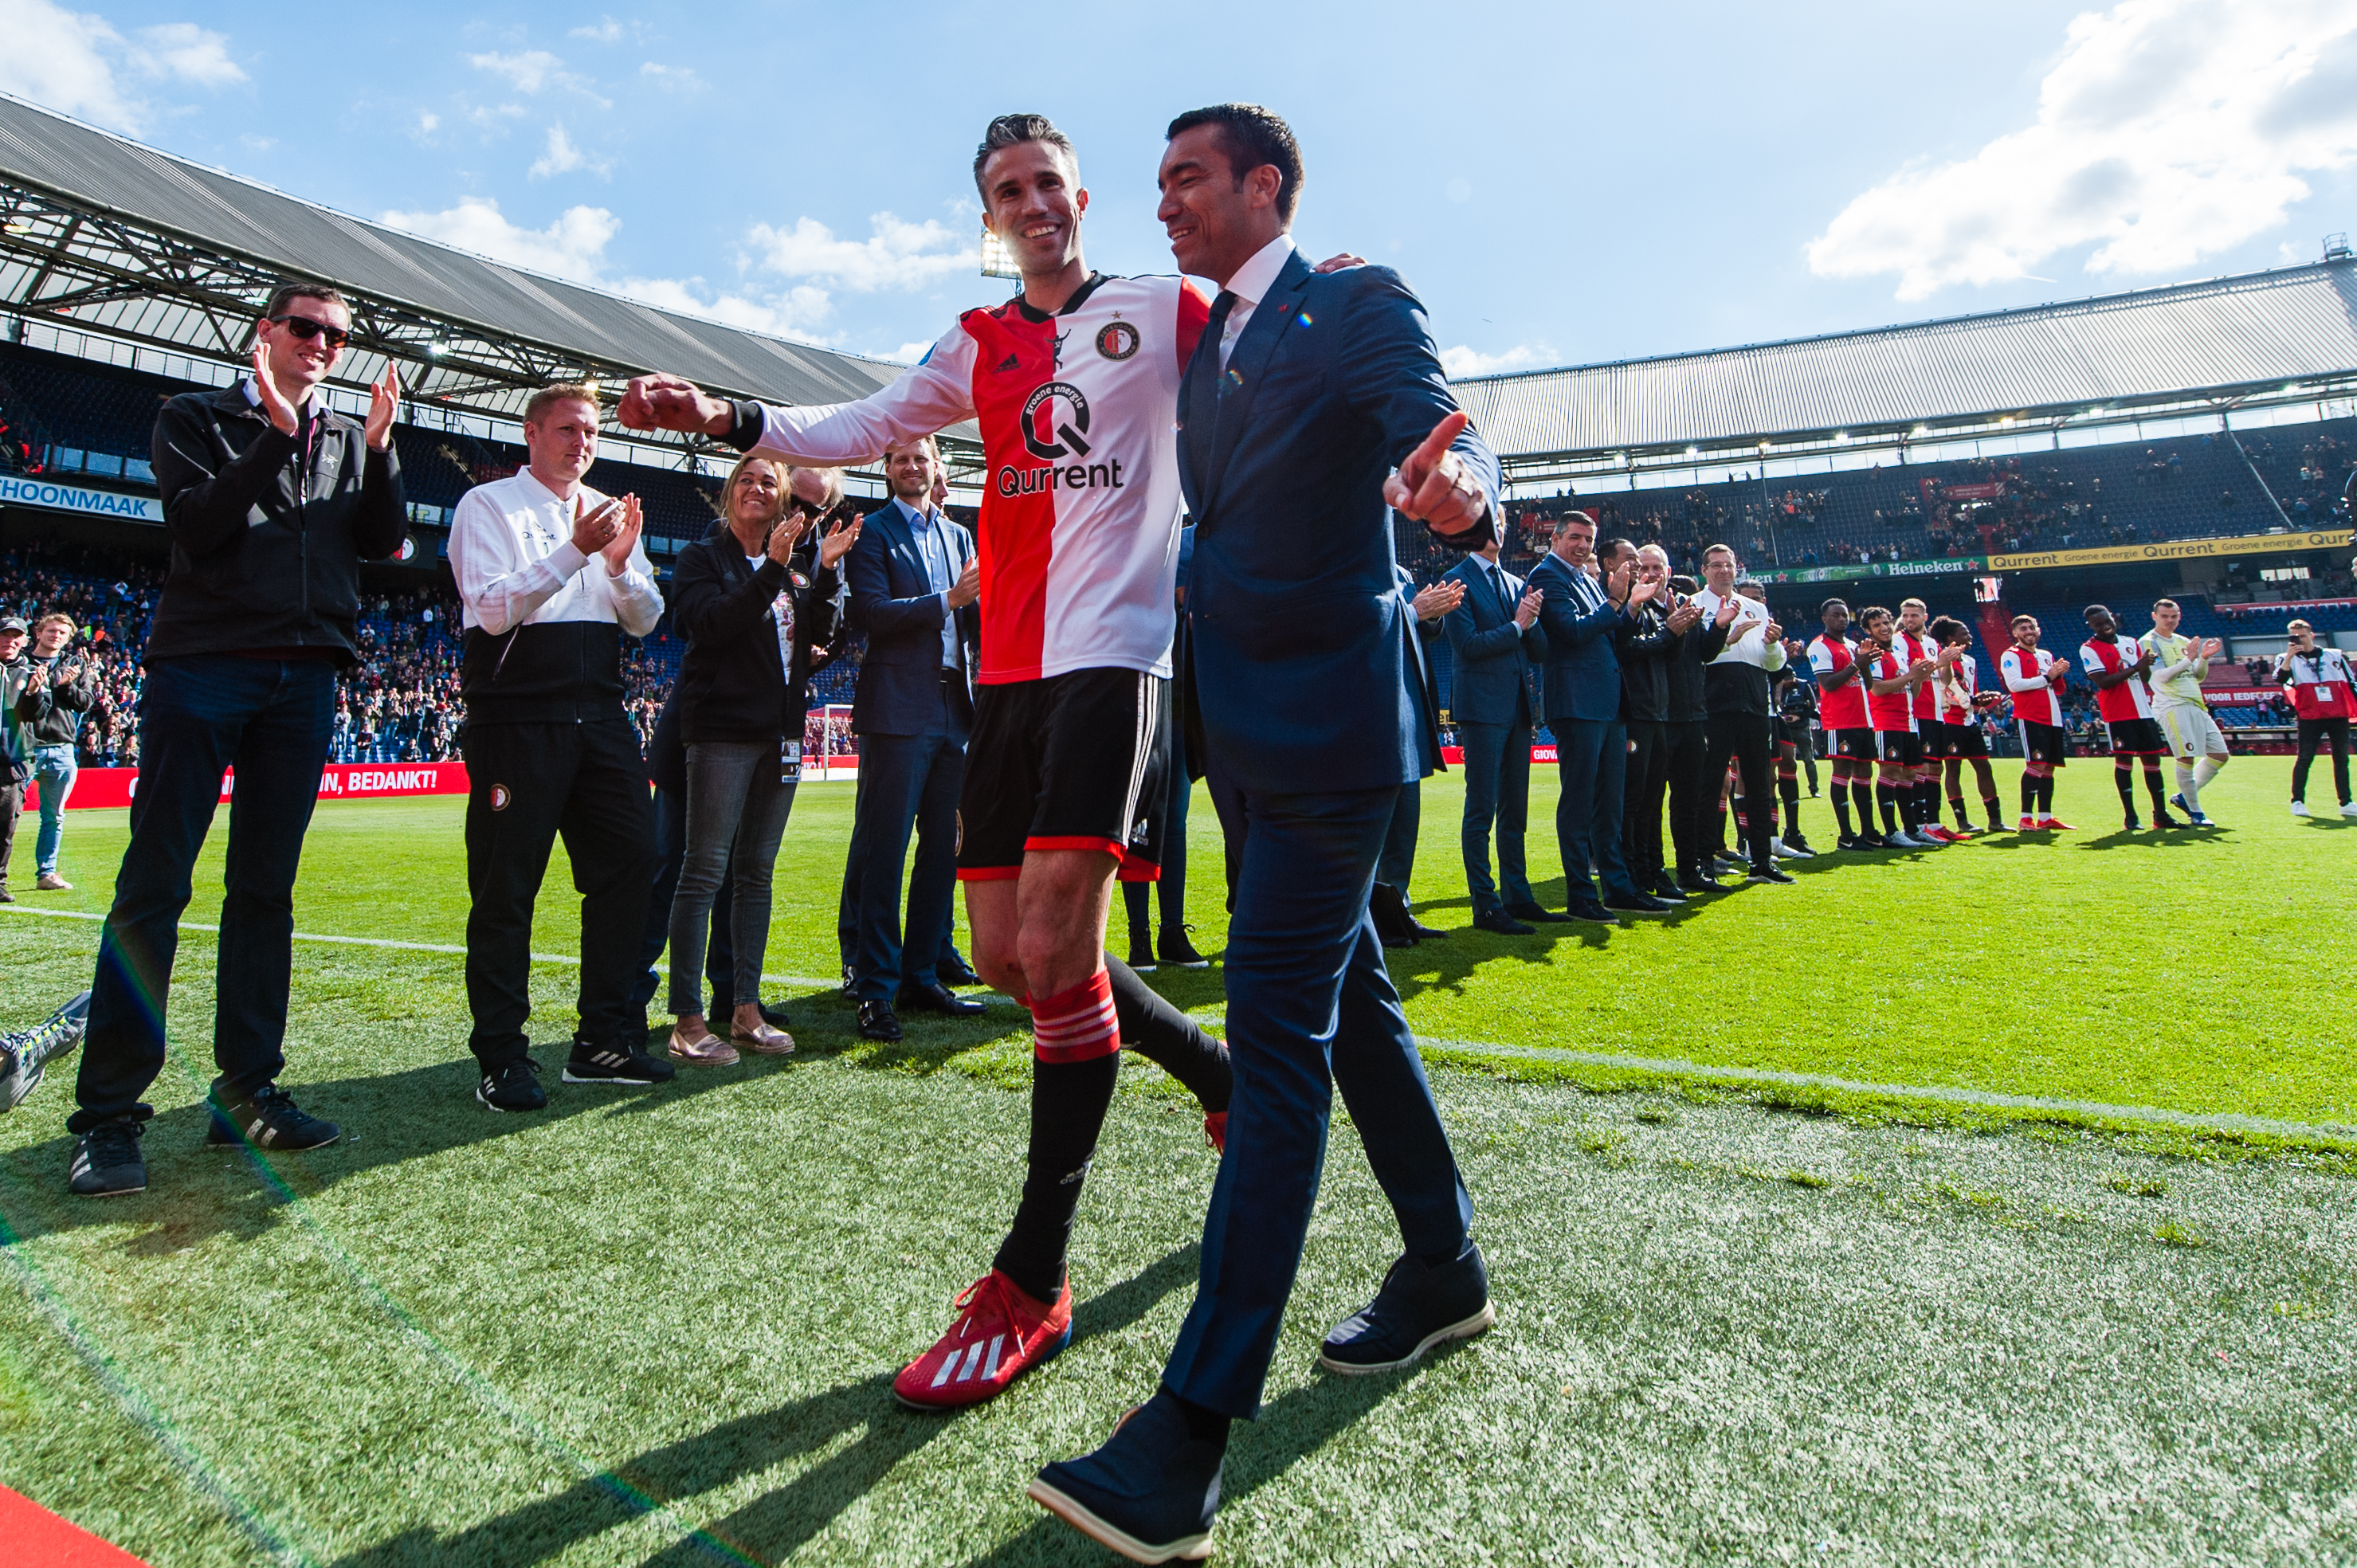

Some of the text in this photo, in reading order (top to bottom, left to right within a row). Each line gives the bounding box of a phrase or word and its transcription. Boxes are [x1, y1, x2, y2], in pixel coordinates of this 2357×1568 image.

[1026, 386, 1084, 415] groene energie
[998, 458, 1124, 498] Qurrent
[0, 480, 148, 516] HOONMAAK
[1993, 554, 2059, 568] Qurrent
[2064, 554, 2099, 563] Groene
[2102, 550, 2139, 559] energie
[2143, 543, 2216, 557] Qurrent
[2222, 543, 2260, 551] Groene
[2263, 537, 2304, 548] energie
[1888, 561, 1963, 576] Heineken
[2203, 692, 2232, 702] VOOR
[347, 770, 437, 791] BEDANKT!
